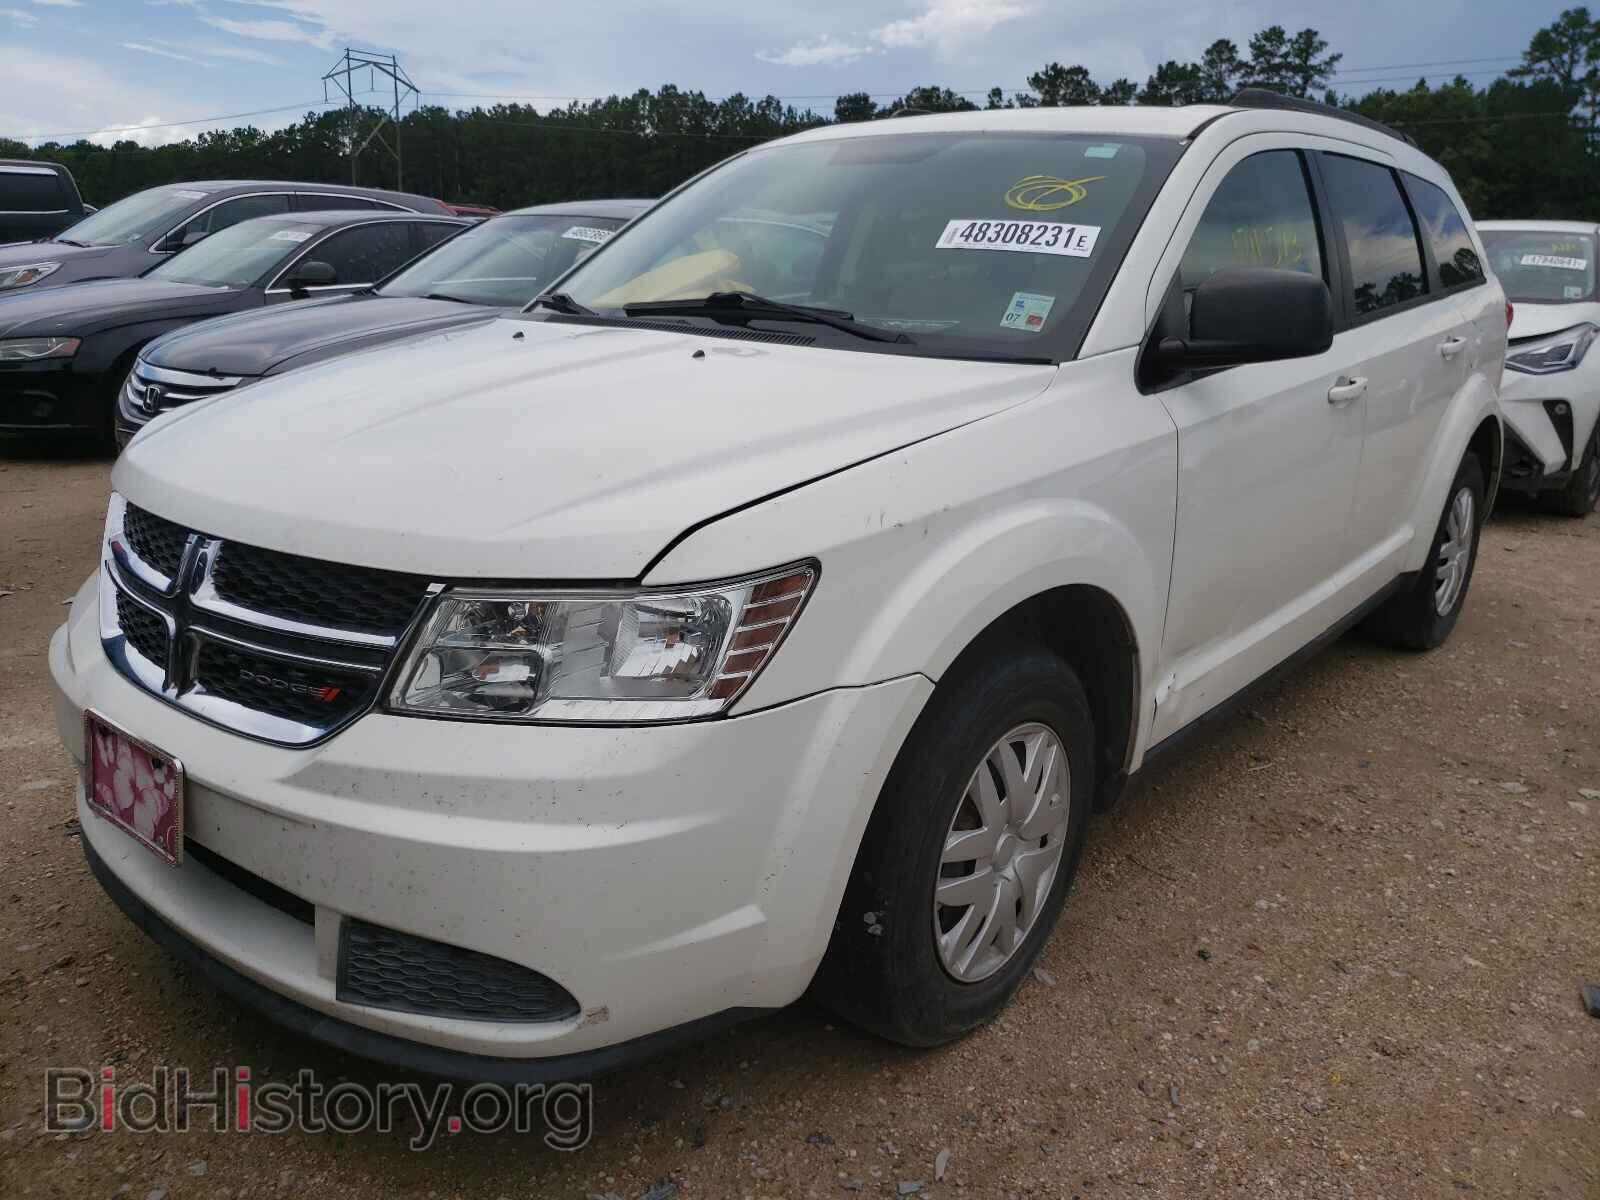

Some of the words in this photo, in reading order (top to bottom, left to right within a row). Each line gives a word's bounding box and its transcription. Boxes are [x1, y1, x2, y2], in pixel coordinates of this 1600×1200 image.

[959, 222, 1076, 249] 48308231
[1076, 235, 1088, 248] E
[1006, 312, 1021, 322] 07
[239, 669, 326, 698] DODGE
